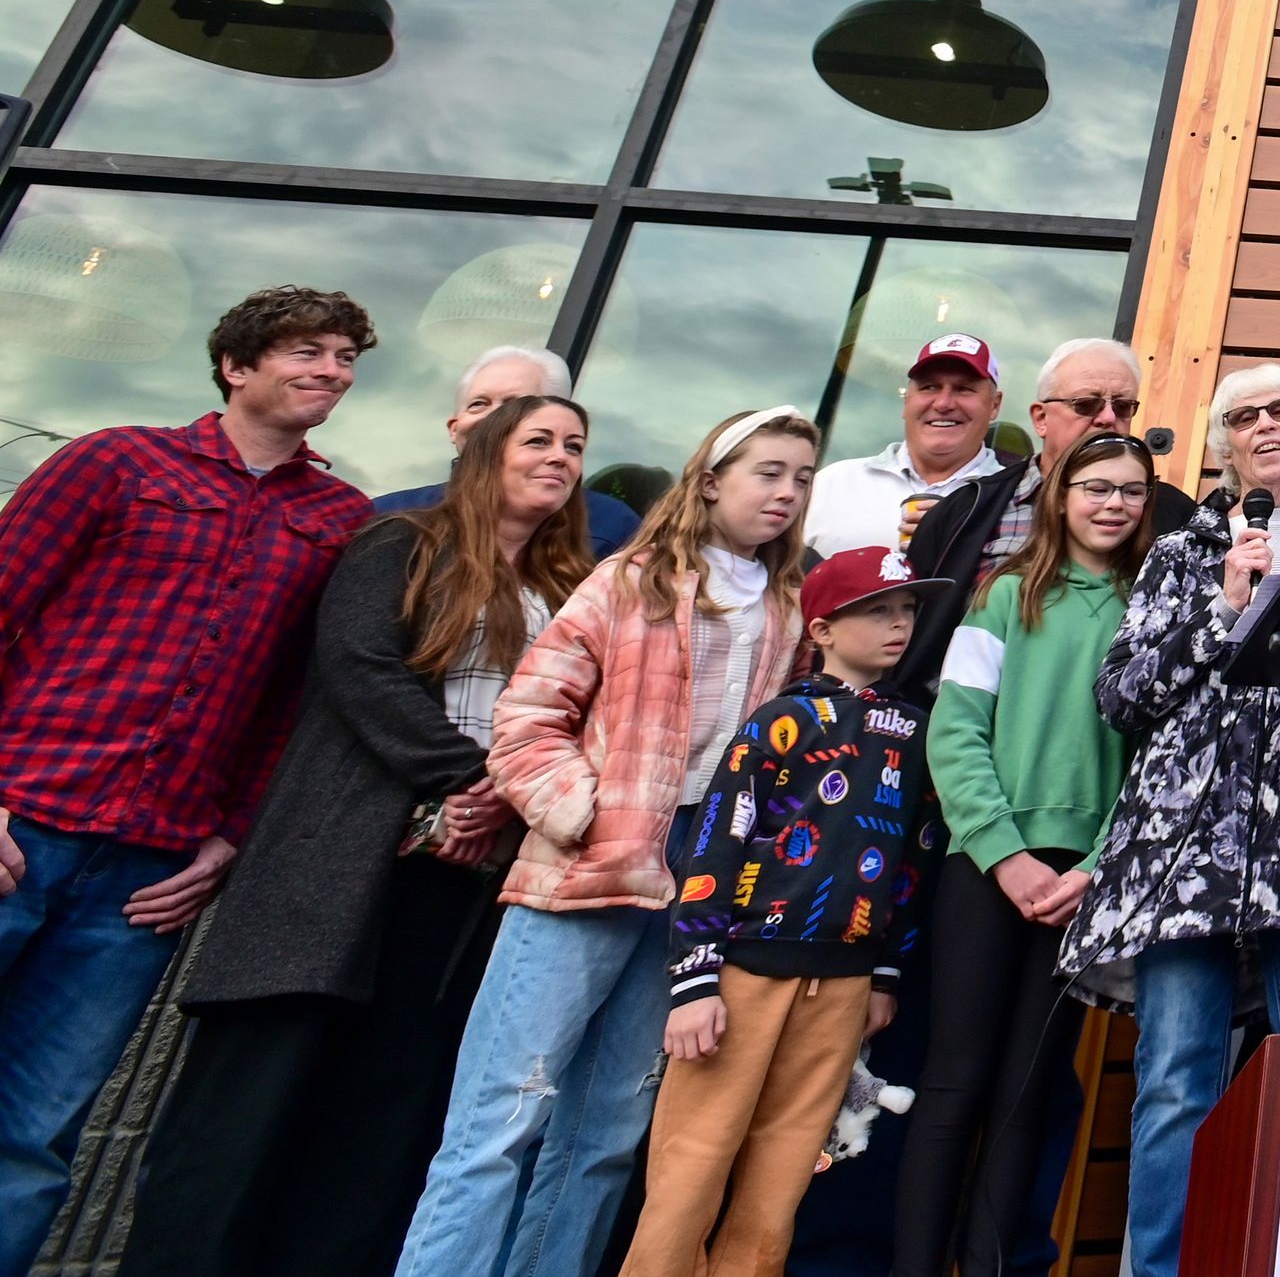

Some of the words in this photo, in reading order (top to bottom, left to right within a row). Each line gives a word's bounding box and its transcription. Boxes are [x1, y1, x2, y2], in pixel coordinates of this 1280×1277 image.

[864, 708, 917, 740] nike
[873, 783, 903, 809] JUST
[881, 766, 902, 790] DO
[693, 791, 723, 857] SWOOSH
[729, 792, 755, 840] NIKE
[786, 823, 812, 859] NIKE
[732, 861, 761, 907] JUST
